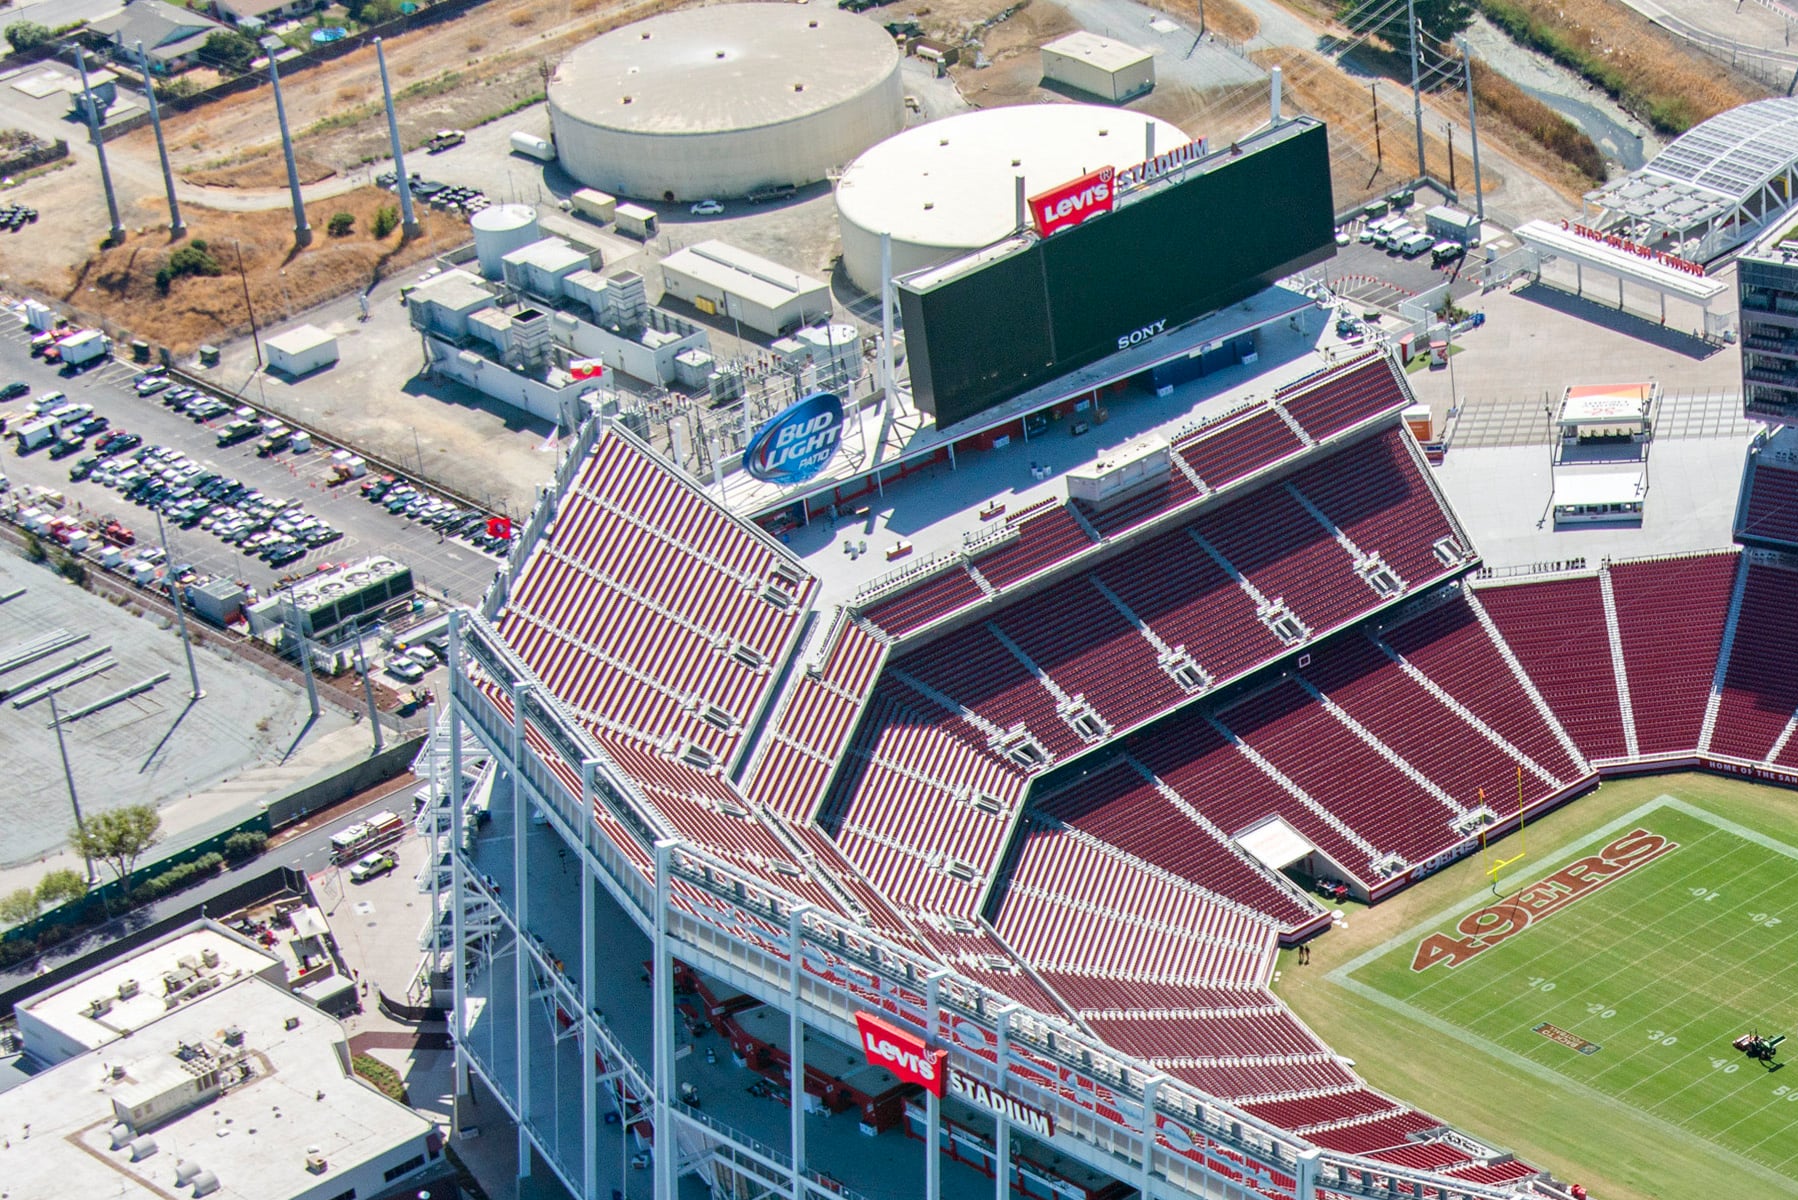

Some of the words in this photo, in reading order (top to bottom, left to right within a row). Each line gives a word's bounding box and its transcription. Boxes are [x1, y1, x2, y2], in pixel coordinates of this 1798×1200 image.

[1119, 136, 1209, 189] STADIUM
[1118, 318, 1167, 350] SONY
[776, 412, 834, 449] BUD
[764, 424, 841, 472] LIGHT
[799, 449, 831, 470] PATIO
[1709, 761, 1738, 775] HOME
[1757, 770, 1775, 780] THE
[1779, 774, 1798, 784] SAN
[1410, 836, 1479, 879] 49ERS
[1410, 828, 1681, 973] 49ERS
[1692, 887, 1720, 901] 10
[1751, 913, 1781, 928] 20
[1528, 977, 1556, 993] 10
[1588, 1003, 1616, 1019] 20
[1648, 1030, 1678, 1046] 30
[1711, 1056, 1739, 1074] 40
[951, 1071, 1050, 1137] STADIUM
